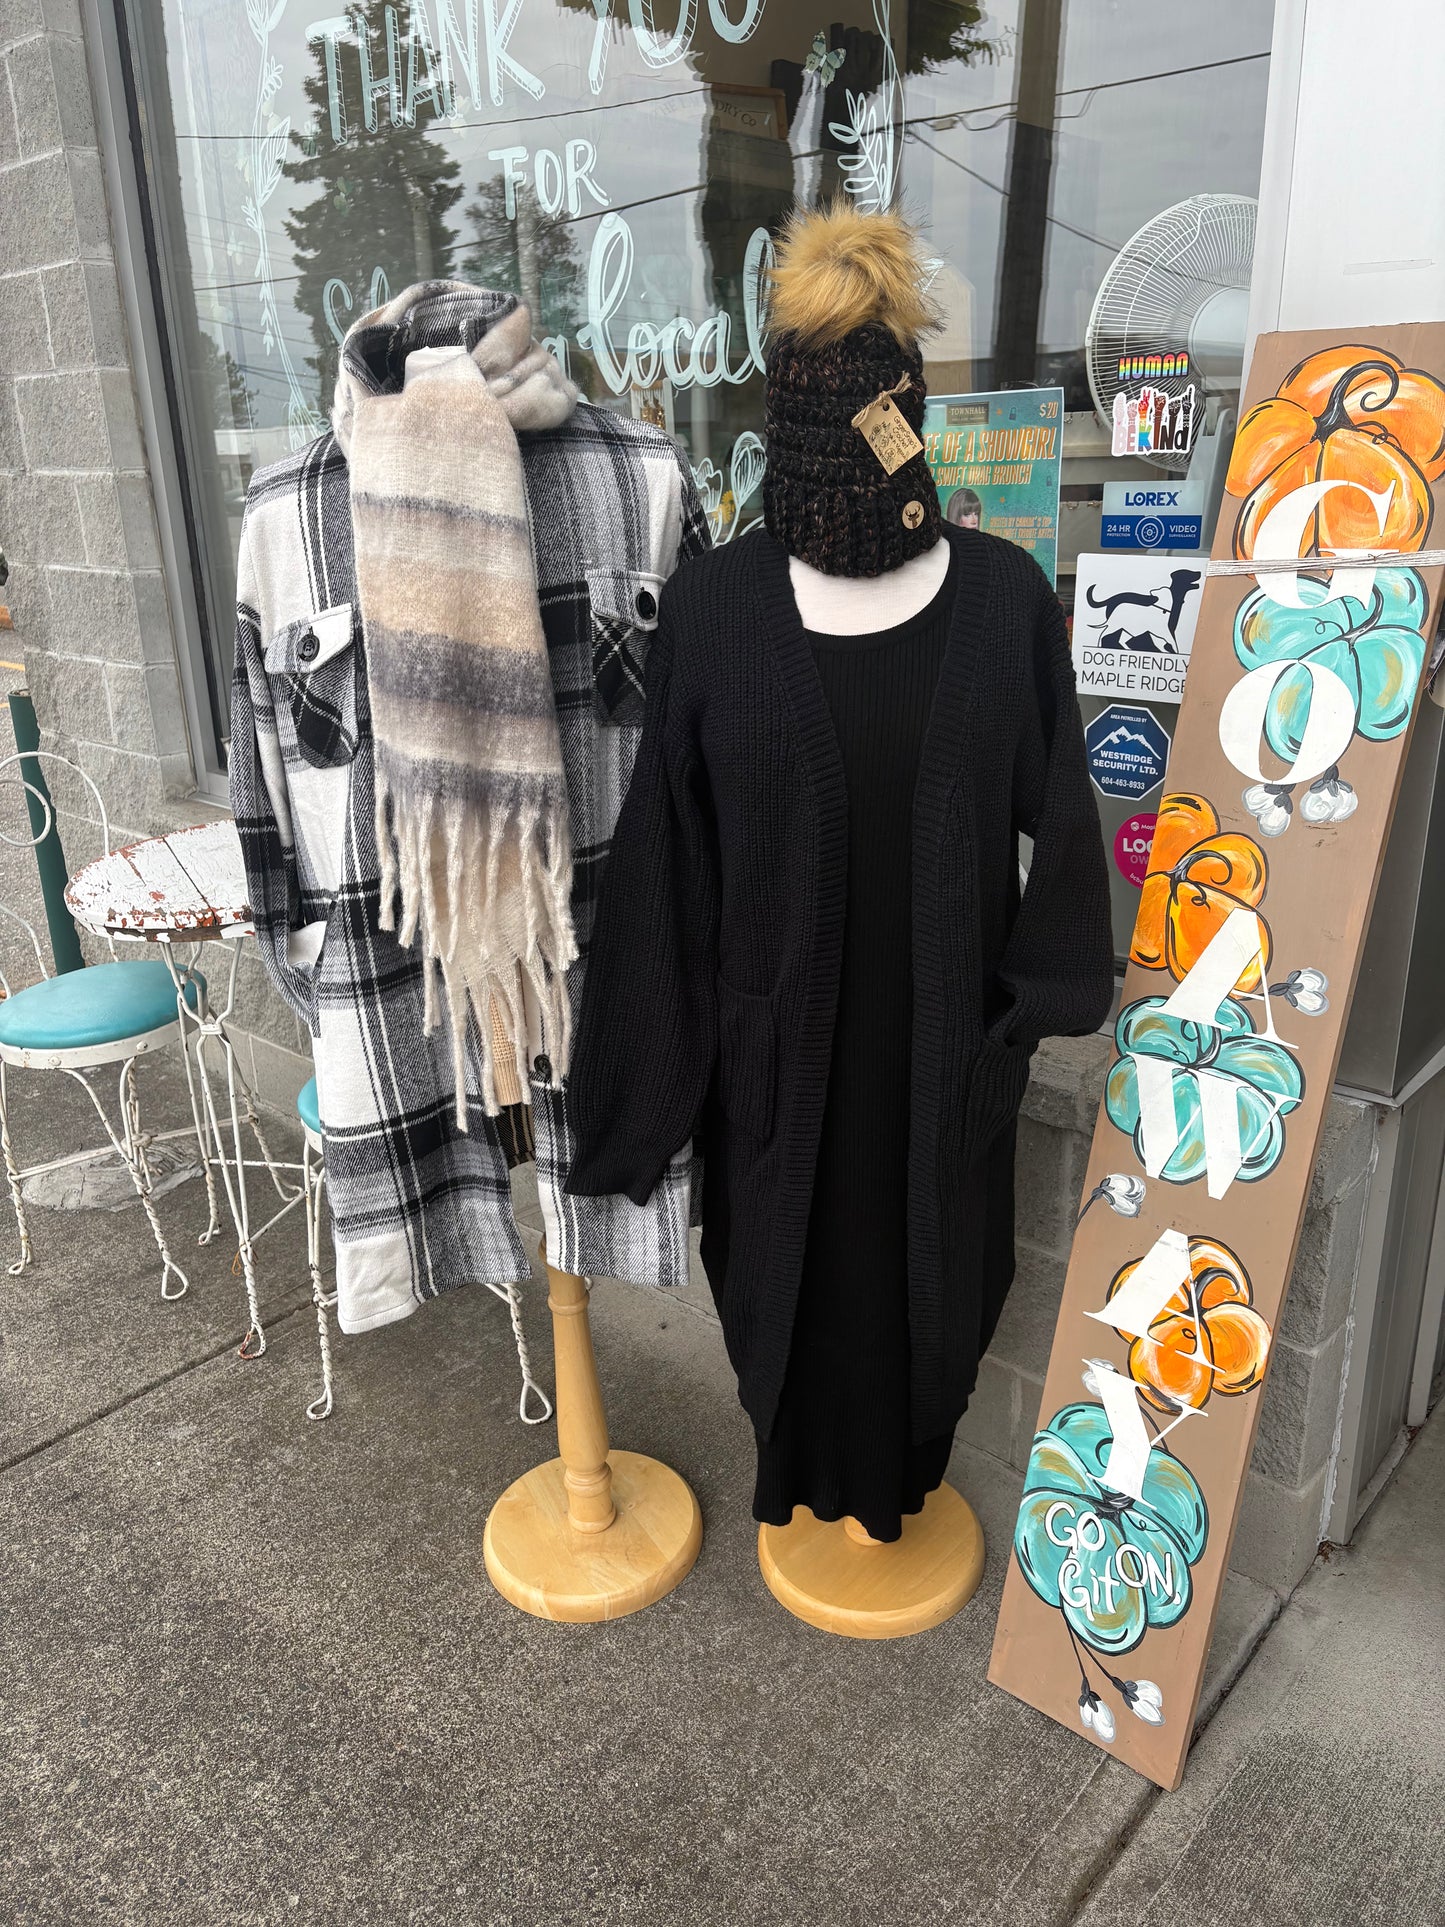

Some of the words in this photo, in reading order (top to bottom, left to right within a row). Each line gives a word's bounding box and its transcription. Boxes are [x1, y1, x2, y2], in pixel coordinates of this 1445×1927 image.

[305, 0, 546, 145] THANK
[488, 138, 612, 221] FOR
[580, 210, 774, 396] local
[951, 406, 986, 416] TOWNHALL
[1039, 401, 1059, 419] $20
[942, 431, 964, 463] OF
[963, 430, 976, 462] A
[977, 426, 1057, 462] SHOWGIRL
[936, 465, 967, 486] SWIFT
[967, 465, 991, 485] DRAG
[992, 463, 1033, 485] BRUNCH
[1125, 491, 1179, 506] LOREX
[1119, 525, 1131, 533] HR
[1169, 525, 1197, 533] VIDEO
[1083, 652, 1115, 666] DOG
[1119, 655, 1189, 673] FRIENDLY
[1081, 670, 1136, 689] MAPLE
[1100, 750, 1153, 764] WESTRIDGE
[1093, 759, 1138, 772] SECURITY
[1139, 766, 1159, 776] LTD.
